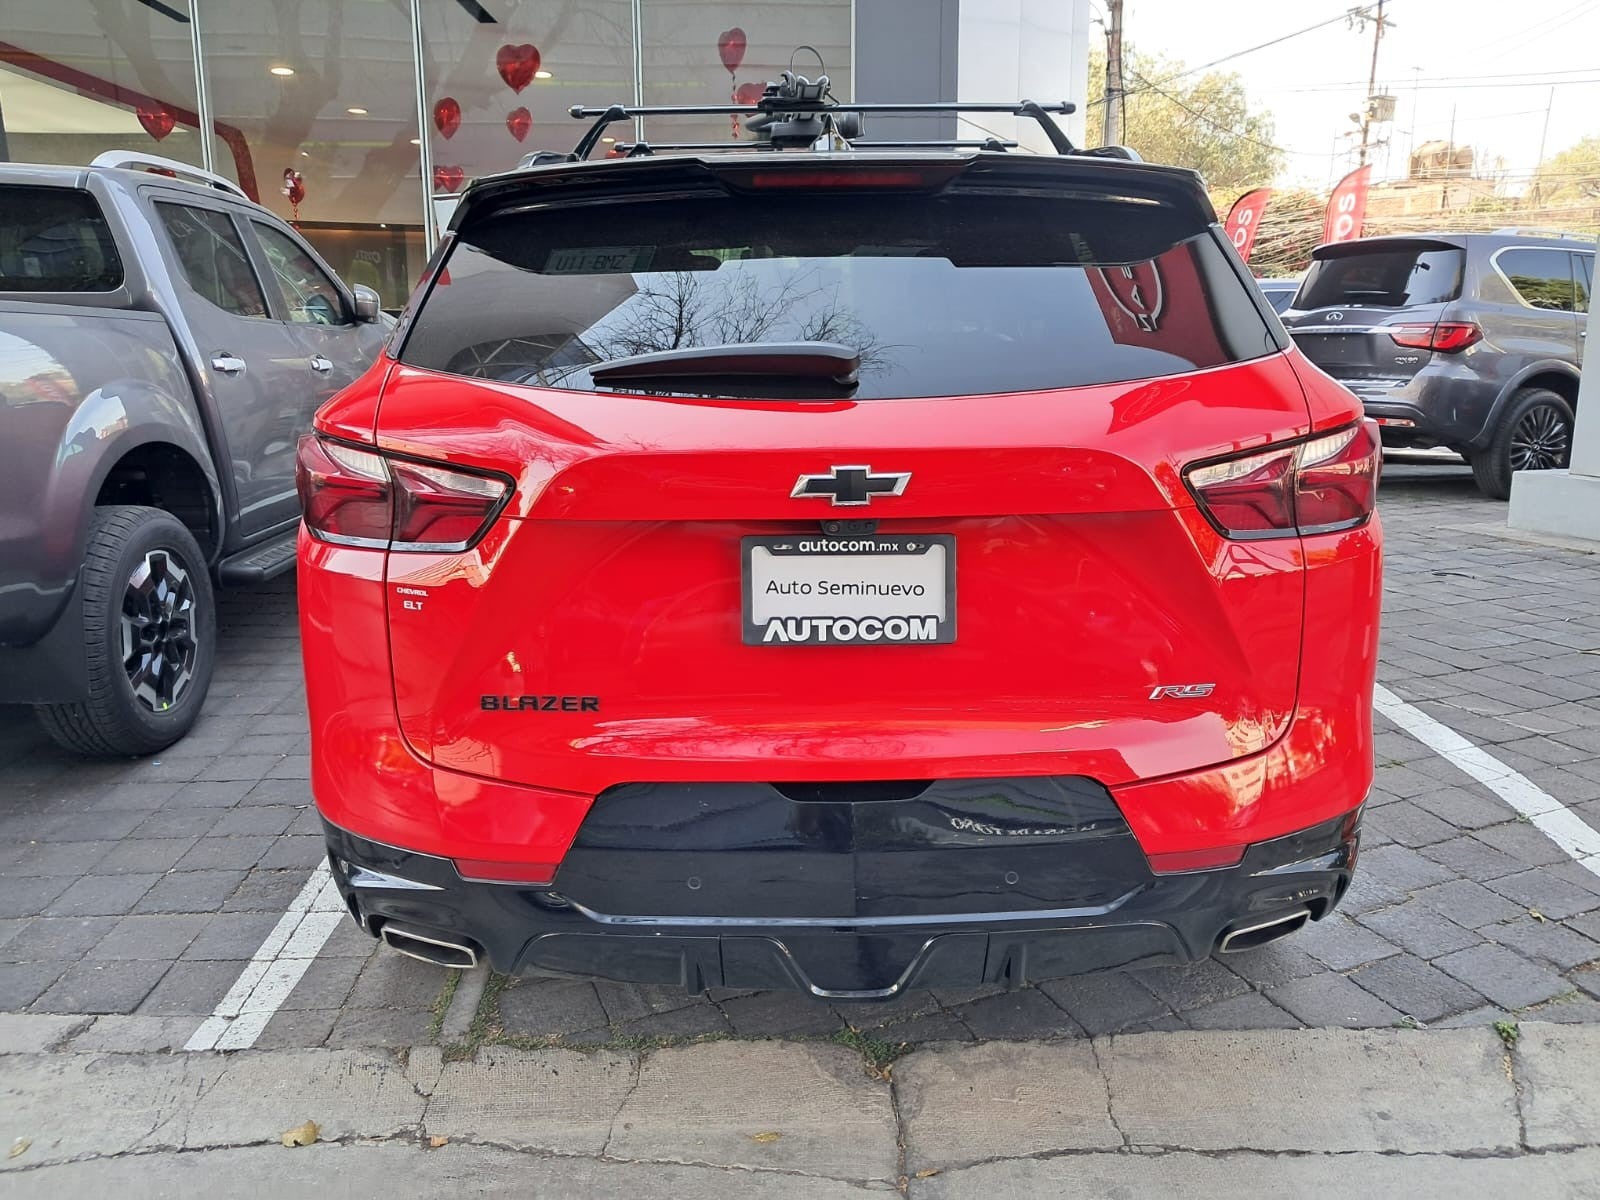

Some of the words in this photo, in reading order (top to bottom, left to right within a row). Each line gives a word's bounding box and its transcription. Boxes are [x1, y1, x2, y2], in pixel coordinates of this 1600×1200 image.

[799, 539, 899, 552] autocom.mx
[766, 580, 812, 595] Auto
[818, 580, 925, 596] Seminuevo
[762, 618, 937, 642] AUTOCOM
[1149, 683, 1216, 700] RS
[480, 695, 600, 712] BLAZER
